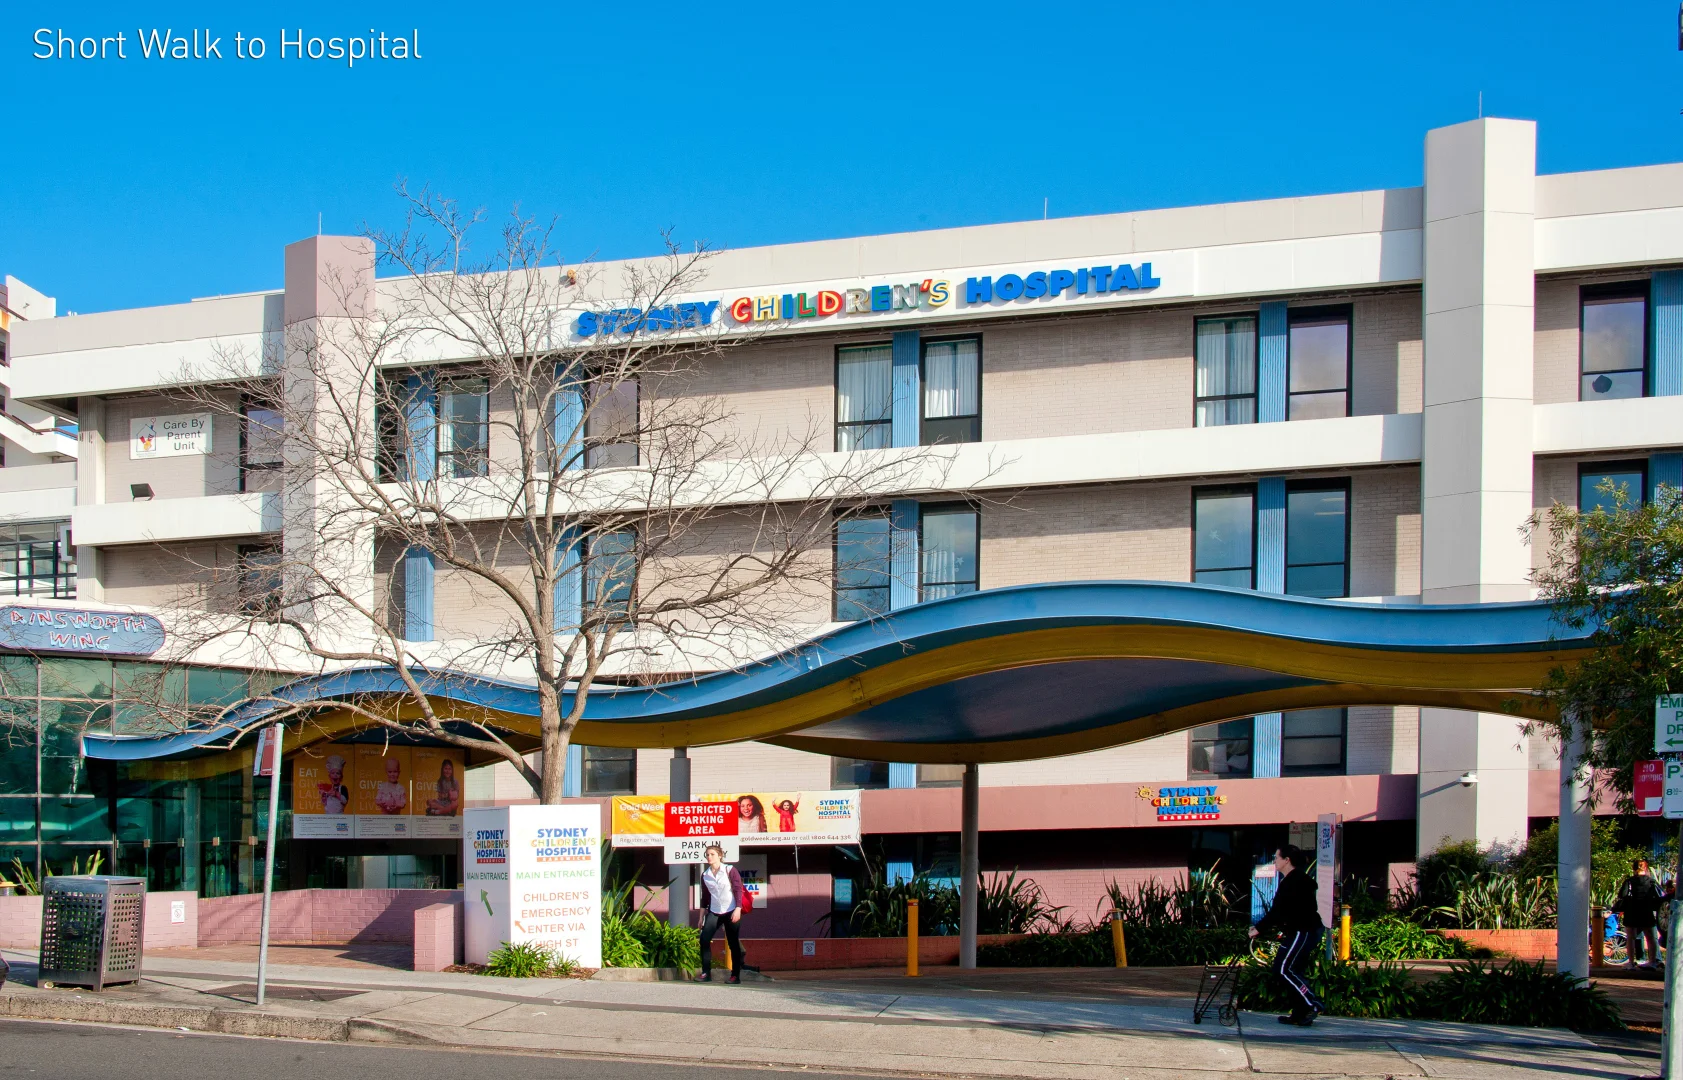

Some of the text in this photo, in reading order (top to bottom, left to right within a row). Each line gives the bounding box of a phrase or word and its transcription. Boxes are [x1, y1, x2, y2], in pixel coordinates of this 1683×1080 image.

[577, 262, 1161, 337] SYDNEY CHILDREN'S HOSPITAL
[163, 418, 205, 430] Care By
[167, 430, 201, 440] Parent
[174, 441, 195, 451] Unit
[10, 610, 147, 633] AINSWORTH
[50, 631, 111, 650] WING
[298, 767, 319, 777] EAT
[359, 780, 383, 790] GIVE
[415, 781, 438, 791] GIVE
[298, 789, 320, 799] LAU
[1159, 786, 1218, 797] SYDNEY
[298, 800, 322, 810] LIVE
[1152, 795, 1228, 807] CHILDREN'S
[641, 803, 665, 811] Week
[671, 805, 733, 815] RESTRICTED
[1157, 805, 1220, 815] HOSPITAL
[679, 815, 724, 825] PARKING
[476, 829, 505, 840] SYDNEY
[537, 827, 588, 838] SYDNEY
[688, 825, 715, 835] AREA
[827, 833, 839, 841] 644
[473, 840, 509, 849] CHILDREN'S
[530, 838, 597, 848] CHILDREN'S
[681, 841, 707, 849] PARK
[476, 849, 506, 858] HOSPITAL
[536, 847, 591, 856] HOSPITAL
[674, 851, 699, 860] BAYS
[466, 872, 508, 881] MAIN ENTRANCE
[516, 869, 596, 880] MAIN ENTRANCE
[523, 891, 590, 903] CHILDREN'S
[521, 907, 592, 919] EMERGENCY
[527, 922, 586, 934] ENTER VIA
[535, 938, 579, 949] HIGH ST
